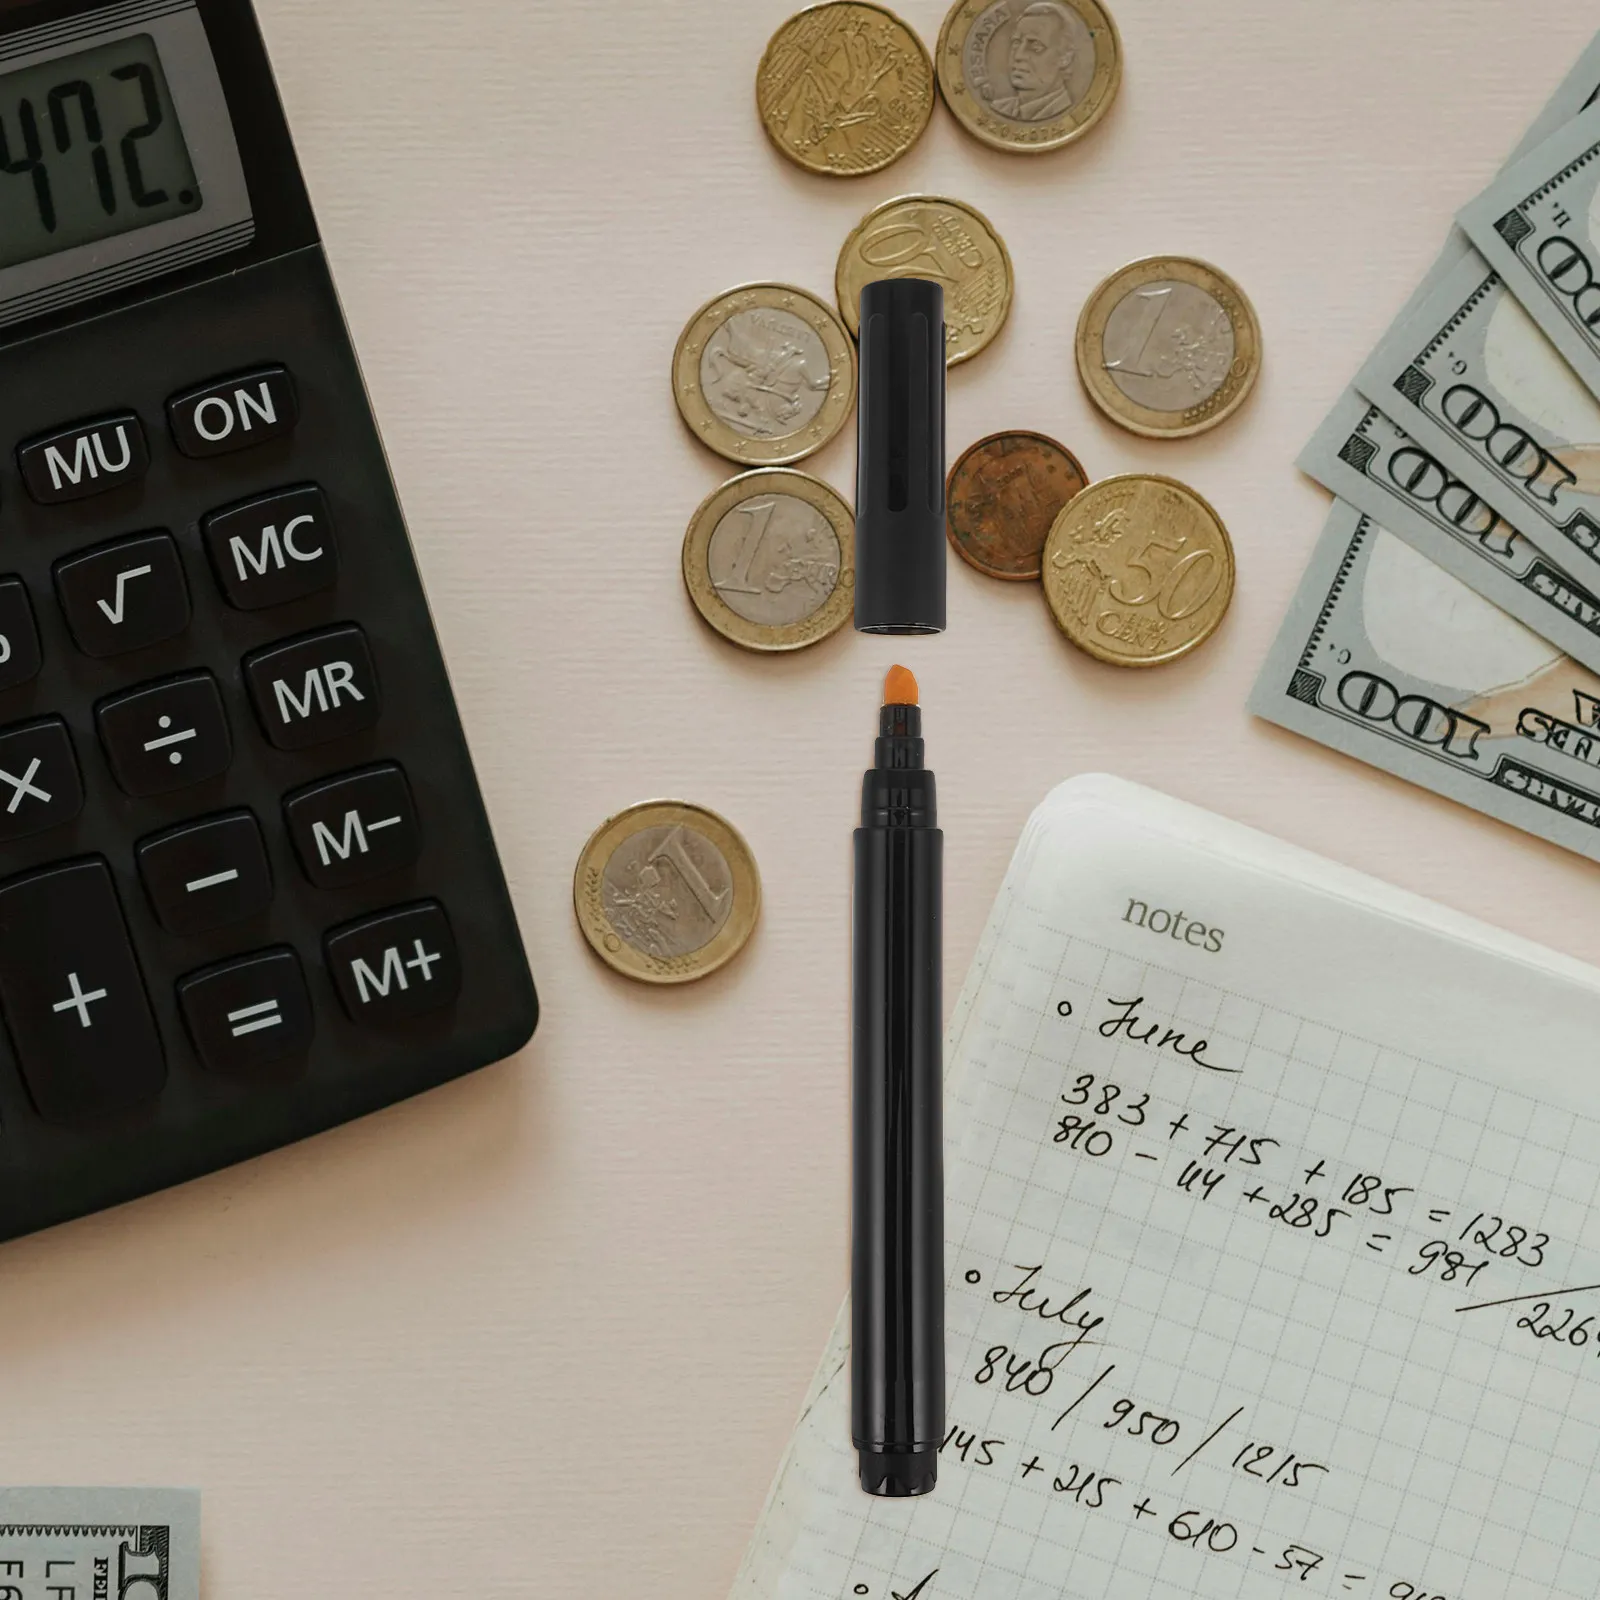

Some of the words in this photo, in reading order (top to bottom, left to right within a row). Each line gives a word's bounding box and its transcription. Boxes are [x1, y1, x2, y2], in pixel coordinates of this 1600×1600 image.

[193, 383, 277, 441] ON
[1441, 383, 1578, 506] 100
[45, 426, 131, 490] MU
[230, 515, 323, 581] MC
[1109, 536, 1217, 621] 50
[273, 661, 365, 724] MR
[1337, 670, 1491, 761] 100
[1121, 898, 1225, 953] notes
[352, 939, 441, 1003] M+
[1099, 996, 1244, 1073] June
[1053, 1115, 1113, 1157] 810
[1177, 1160, 1226, 1201] 44
[1408, 1239, 1489, 1288] 981
[1061, 1074, 1150, 1126] 383
[1204, 1125, 1281, 1165] 715
[1342, 1172, 1414, 1215] 185
[1459, 1213, 1550, 1268] 1283
[993, 1265, 1108, 1370] July
[1517, 1302, 1600, 1357] 226
[975, 1346, 1053, 1397] 840
[1103, 1398, 1181, 1446] 950
[1232, 1442, 1330, 1487] 1215
[939, 1425, 1006, 1466] 145
[1053, 1464, 1123, 1508] 215
[1168, 1510, 1238, 1552] 610
[1275, 1545, 1325, 1581] 57
